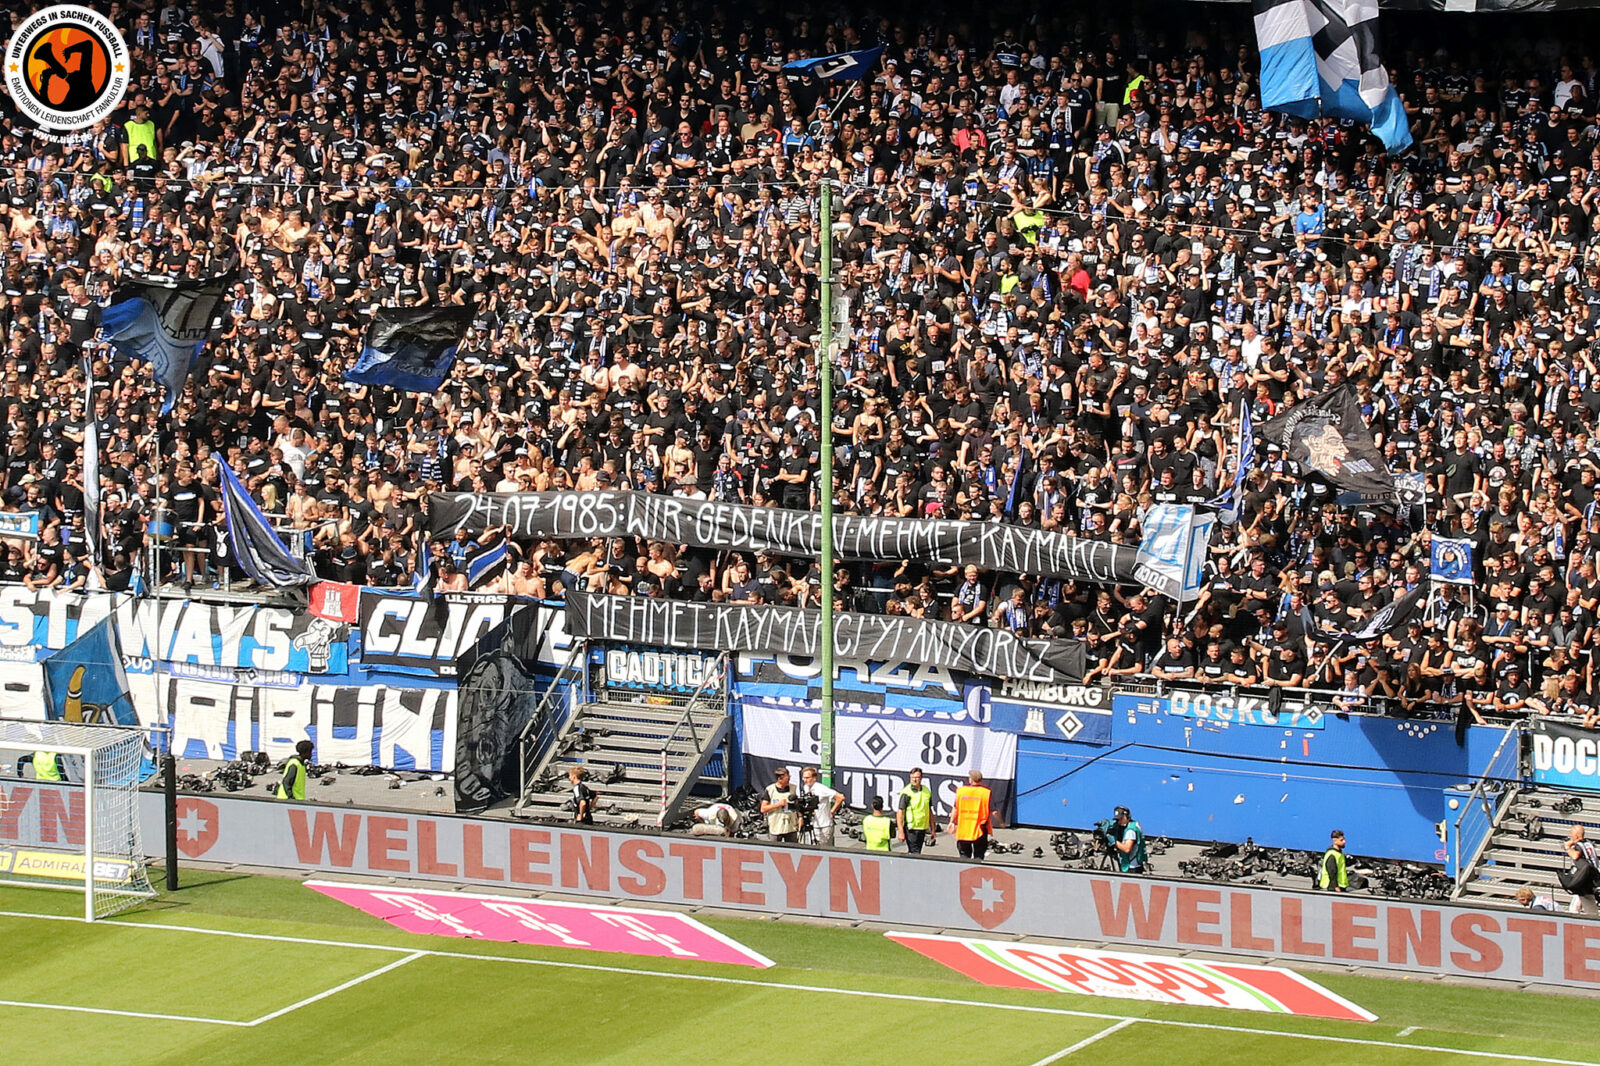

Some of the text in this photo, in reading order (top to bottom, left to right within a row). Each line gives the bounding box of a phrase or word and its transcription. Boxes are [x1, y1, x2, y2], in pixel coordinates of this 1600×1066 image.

[627, 494, 683, 541] WIR
[695, 503, 848, 559] GEDENKEN
[855, 517, 971, 565] MEHMET
[445, 594, 509, 604] ULTRAS
[586, 594, 706, 648] MEHMET
[1000, 678, 1104, 706] HAMBURG
[919, 731, 968, 768] 89
[1533, 733, 1600, 777] DOC
[94, 863, 130, 878] BET
[287, 808, 881, 916] WELLENSTEYN
[1090, 879, 1600, 984] WELLENSTE
